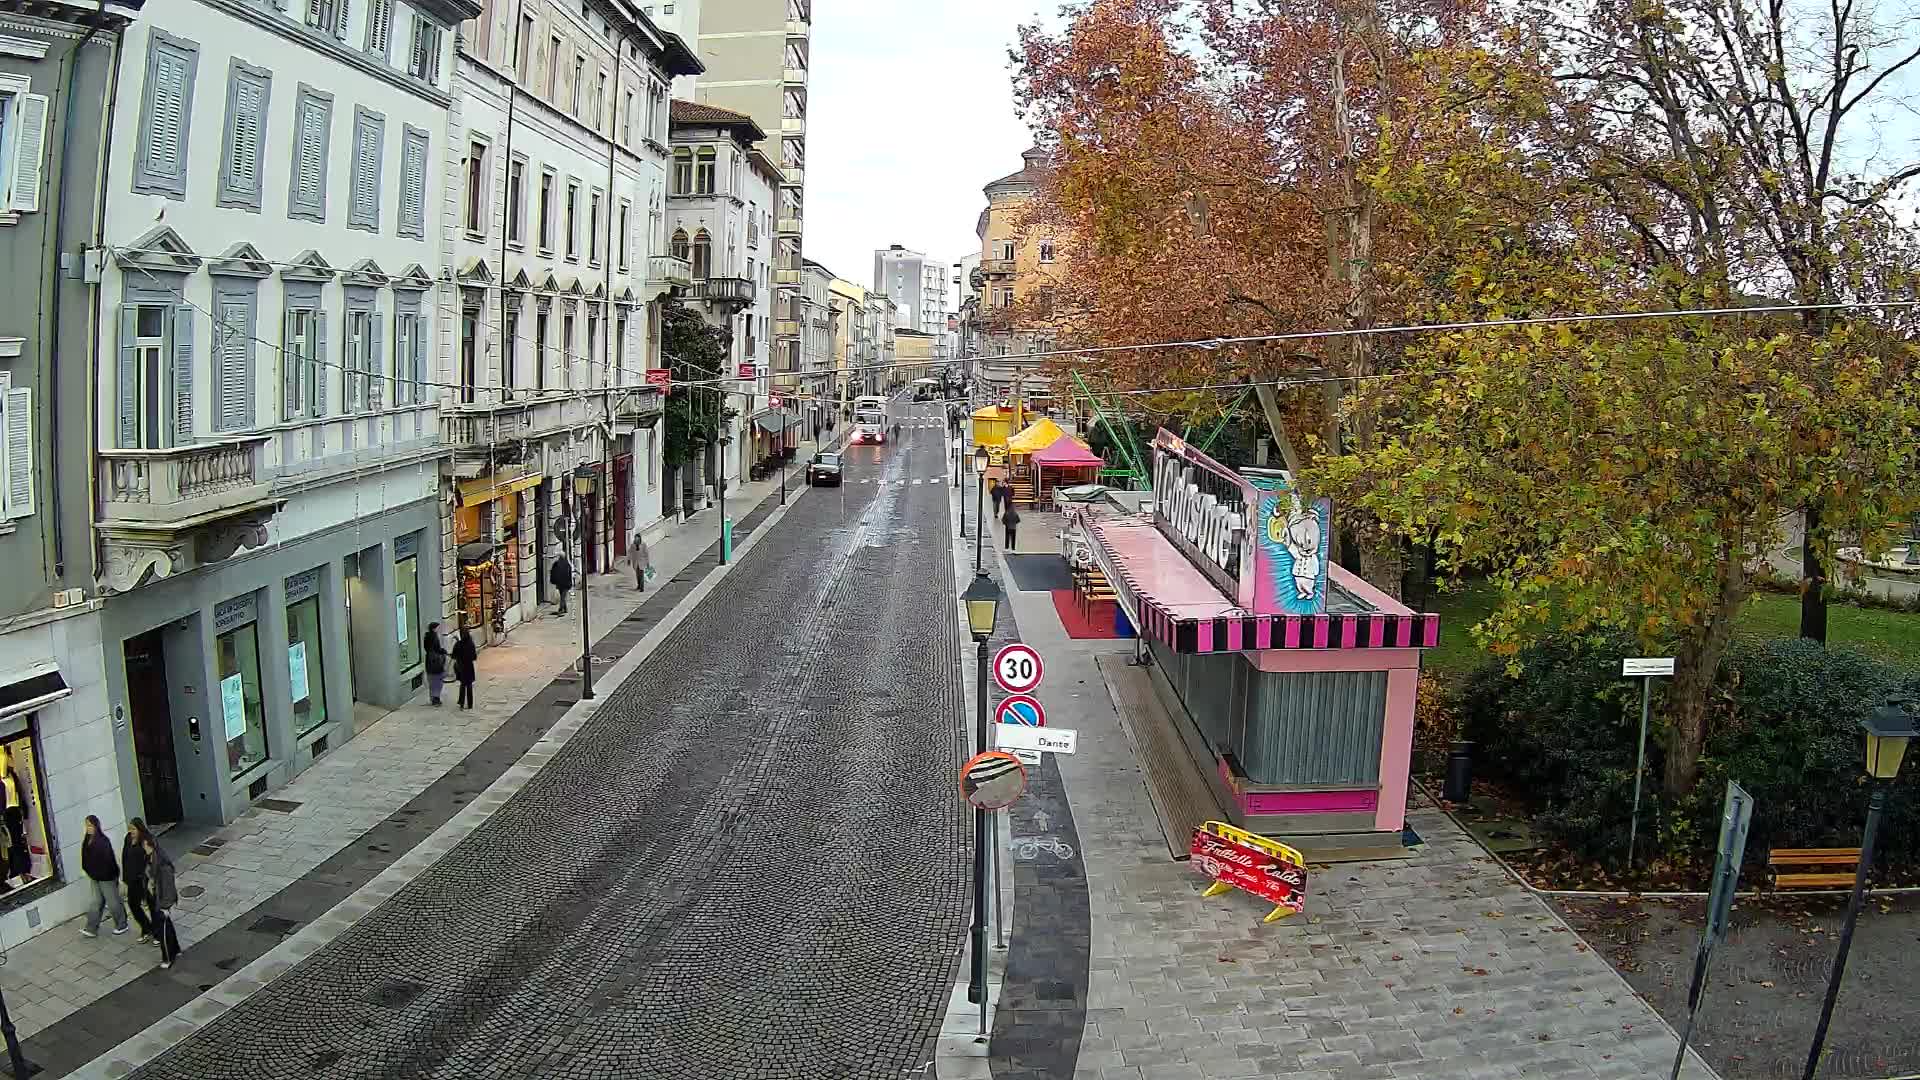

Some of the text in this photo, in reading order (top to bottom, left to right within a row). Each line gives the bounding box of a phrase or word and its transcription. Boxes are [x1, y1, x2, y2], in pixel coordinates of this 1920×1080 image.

[1006, 658, 1032, 679] 30
[1038, 737, 1070, 749] Dante
[1203, 840, 1253, 868] Frittelle
